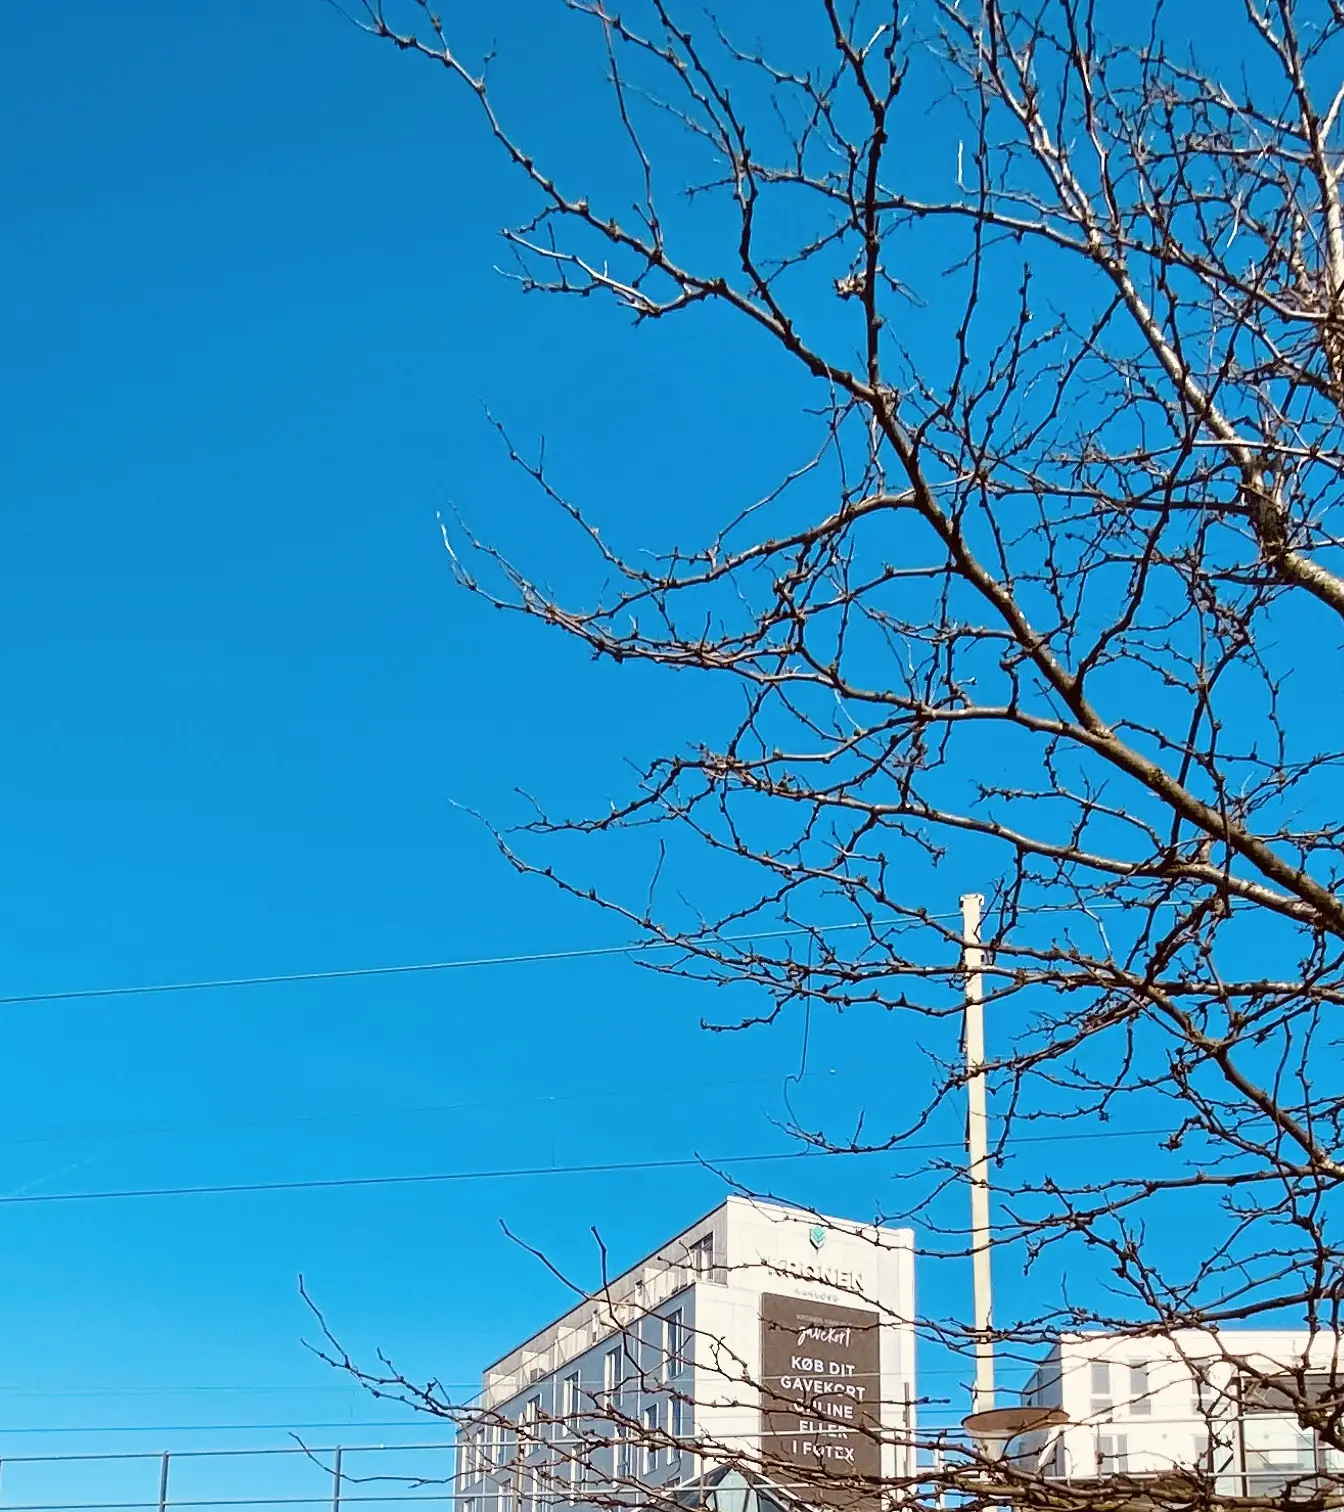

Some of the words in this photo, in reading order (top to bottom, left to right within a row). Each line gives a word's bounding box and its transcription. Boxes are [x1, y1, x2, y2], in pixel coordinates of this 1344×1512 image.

[791, 1356, 824, 1373] KØB
[829, 1362, 855, 1377] DIT
[780, 1375, 866, 1402] GAVEKORT
[799, 1420, 848, 1439] ELLER
